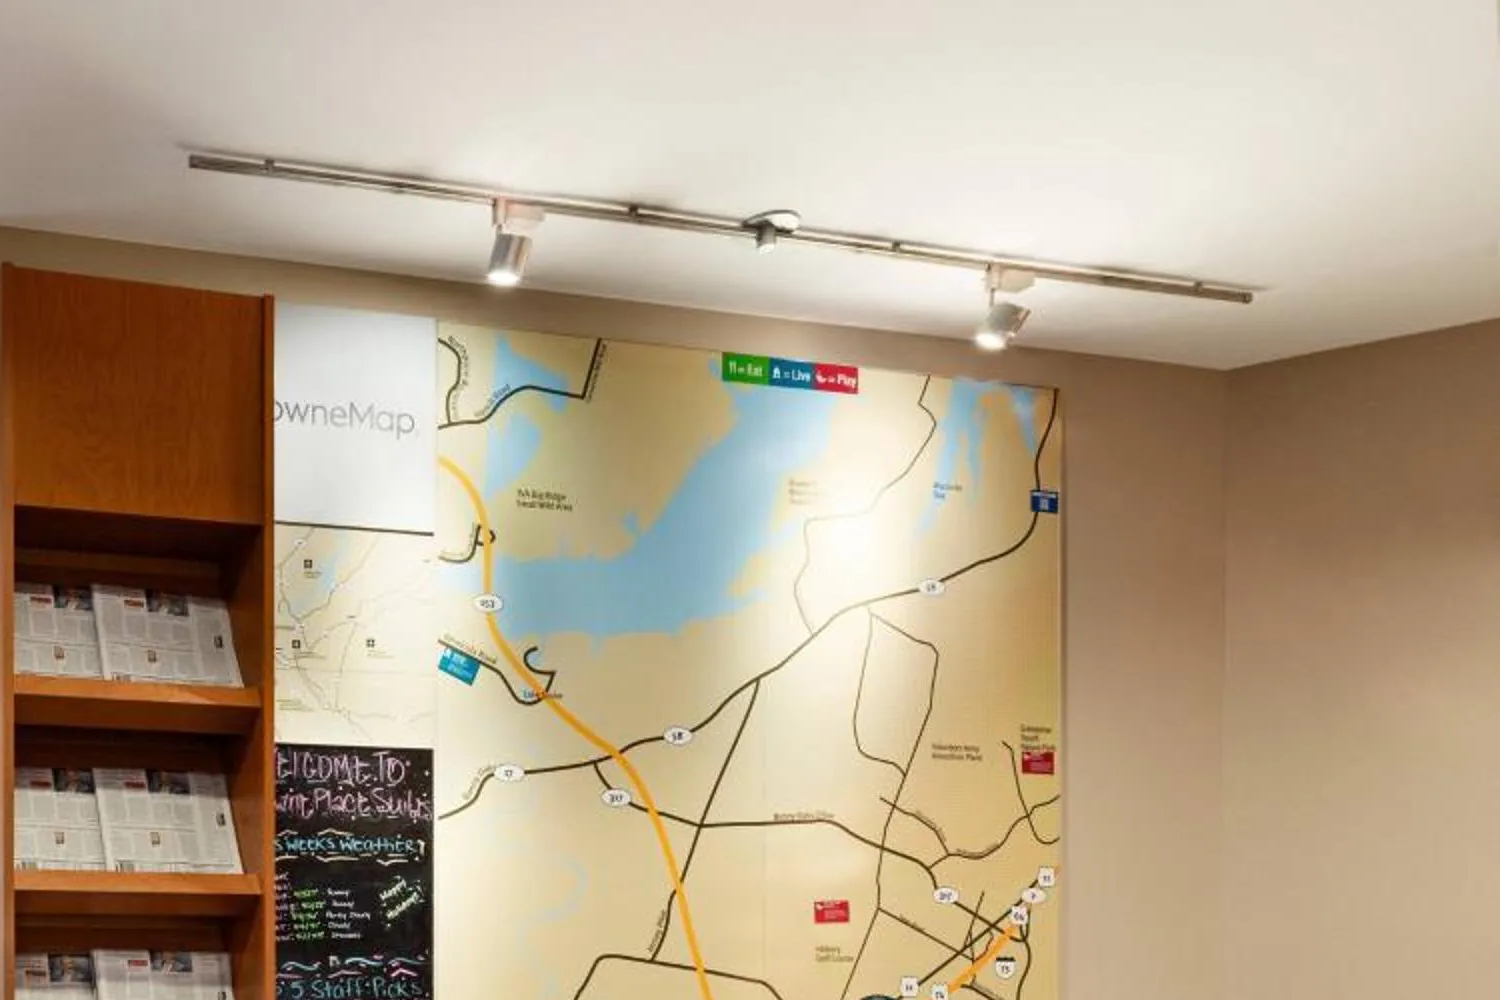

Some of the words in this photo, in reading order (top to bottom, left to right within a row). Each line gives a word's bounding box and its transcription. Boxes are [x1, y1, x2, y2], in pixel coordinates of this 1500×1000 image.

[791, 369, 811, 383] Live
[837, 373, 857, 389] Play
[274, 400, 415, 440] owneMap
[291, 980, 304, 999] 5
[312, 978, 364, 999] Staff
